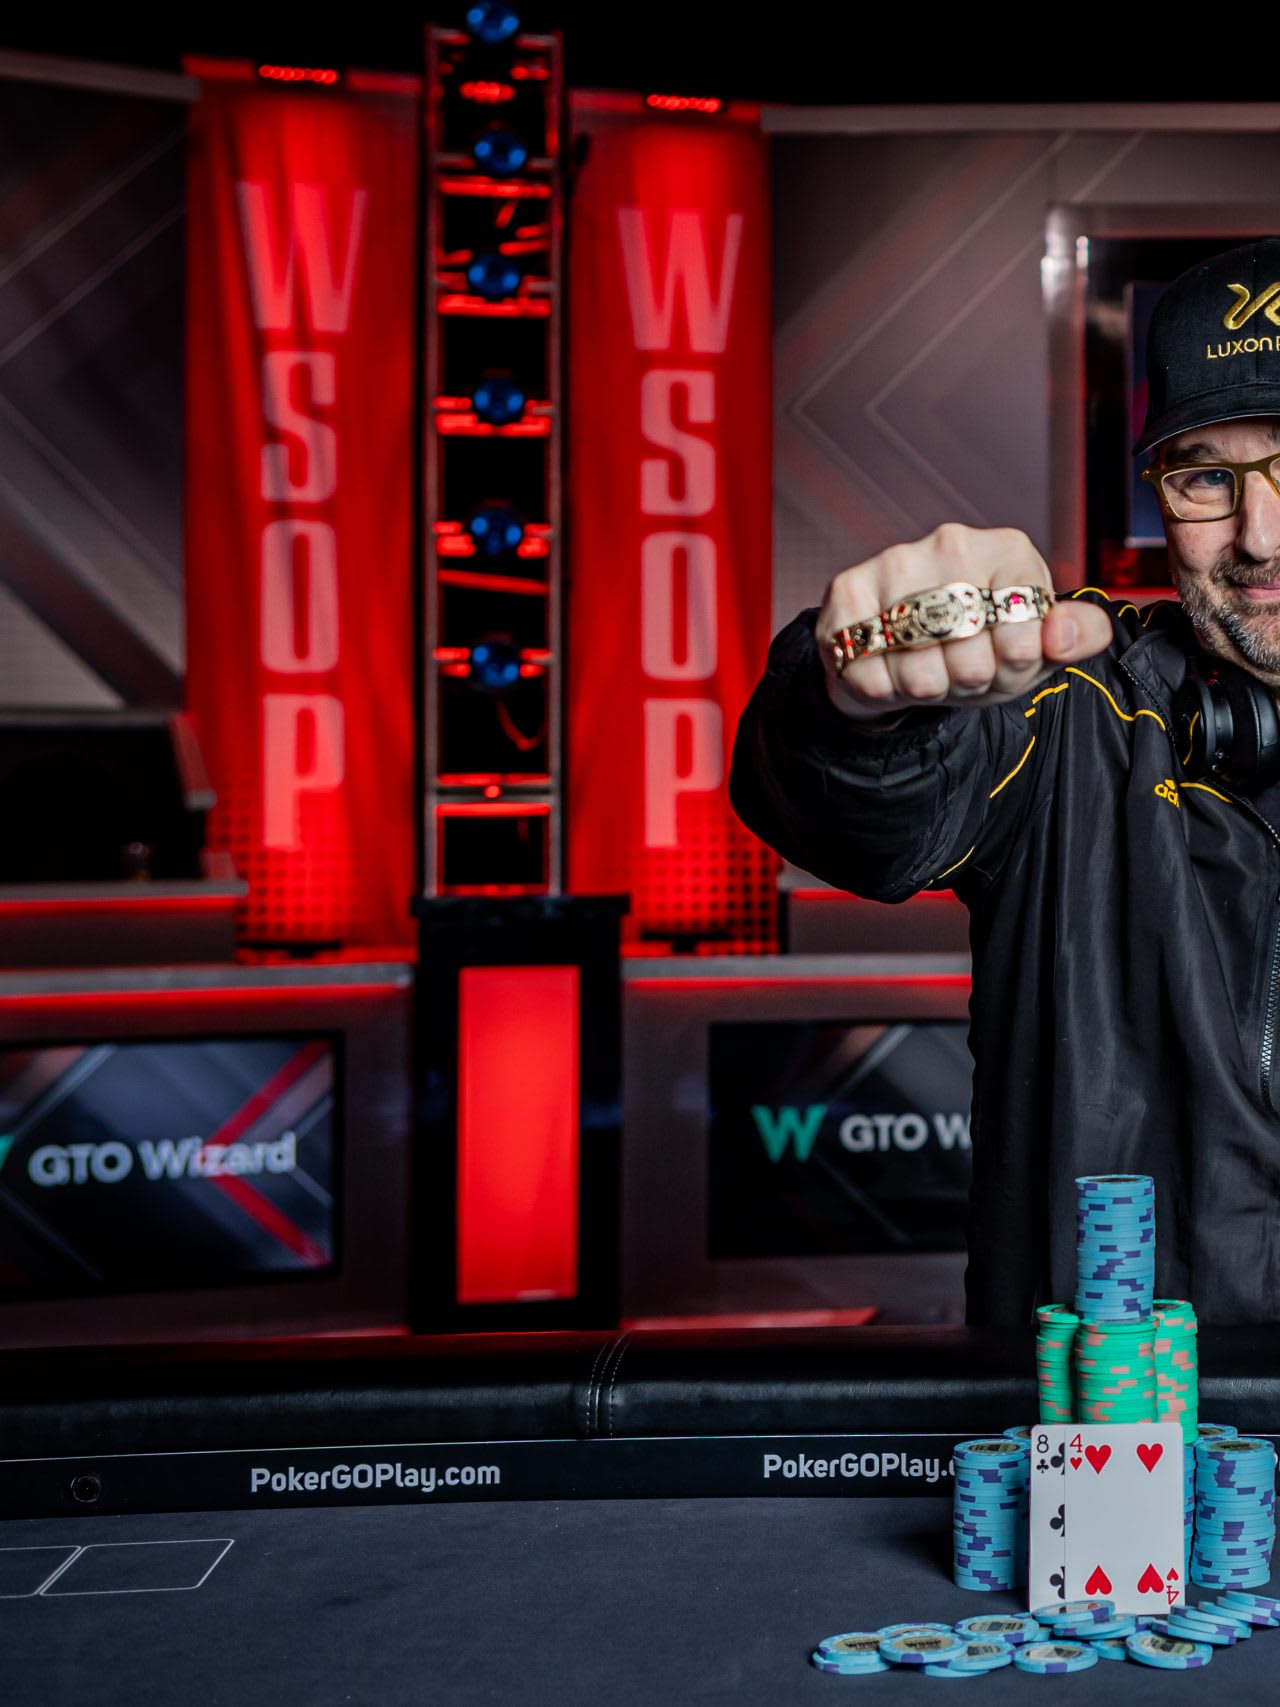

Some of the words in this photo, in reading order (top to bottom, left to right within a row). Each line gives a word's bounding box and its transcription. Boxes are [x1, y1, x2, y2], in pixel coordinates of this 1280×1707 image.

[238, 181, 367, 848] WSOP
[617, 208, 743, 848] WSOP
[840, 1113, 929, 1151] GTO
[28, 1142, 133, 1186] GTO
[137, 1130, 297, 1181] Wizard
[1036, 1434, 1049, 1454] 8
[1069, 1433, 1083, 1453] 4
[251, 1462, 501, 1493] PokerGOPlay.com
[1166, 1585, 1179, 1605] 4
